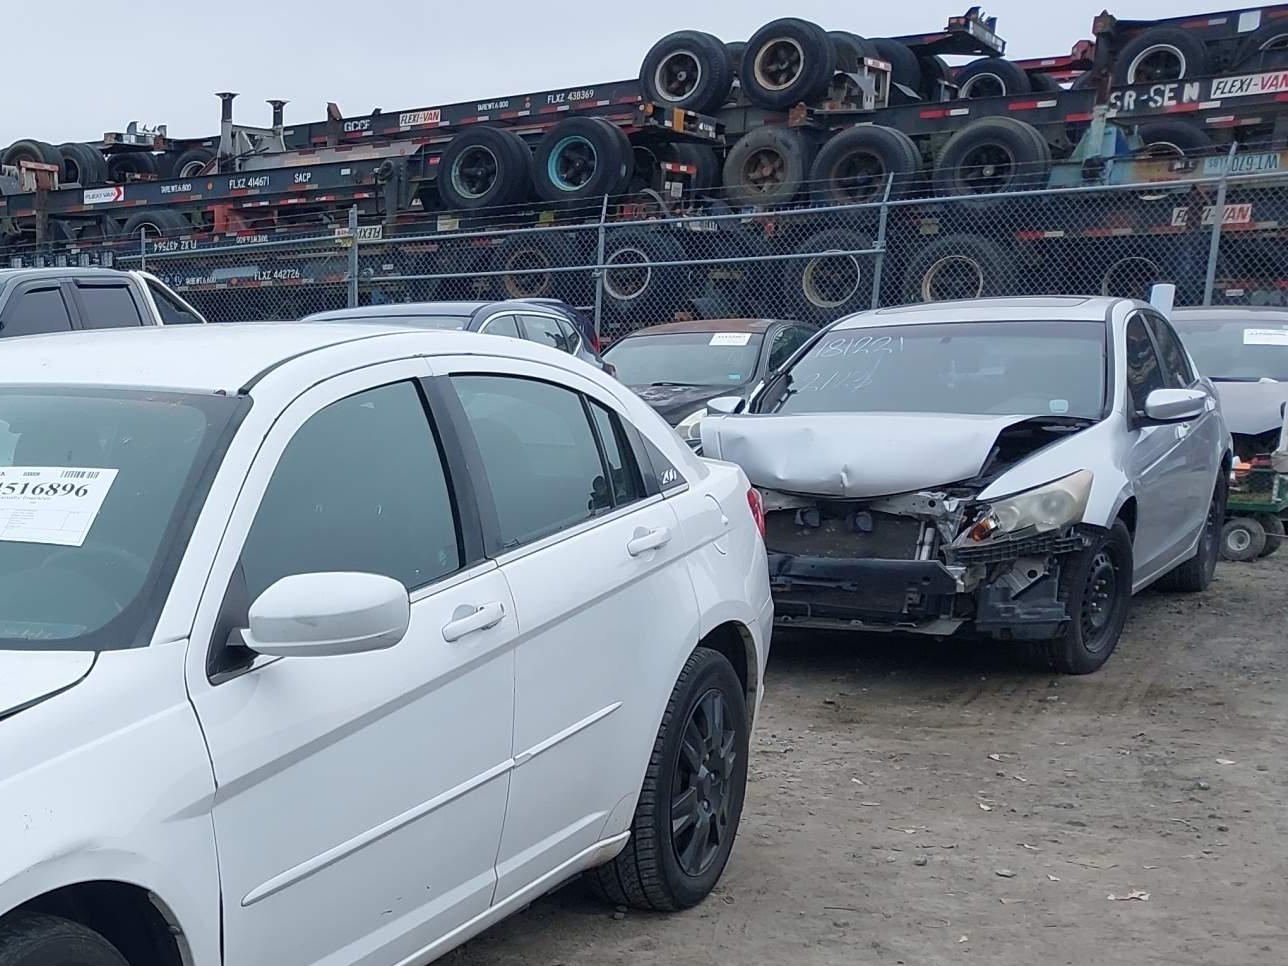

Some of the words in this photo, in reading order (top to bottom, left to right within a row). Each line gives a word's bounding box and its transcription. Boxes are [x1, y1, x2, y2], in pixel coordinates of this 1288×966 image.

[547, 93, 565, 105] FLXZ
[400, 110, 440, 125] FLEXI-VAN
[229, 178, 246, 189] FLXZ
[294, 172, 312, 184] SACP
[1175, 206, 1250, 225] FLI-AN
[180, 240, 197, 249] FLXZ
[254, 271, 271, 280] FLXZ
